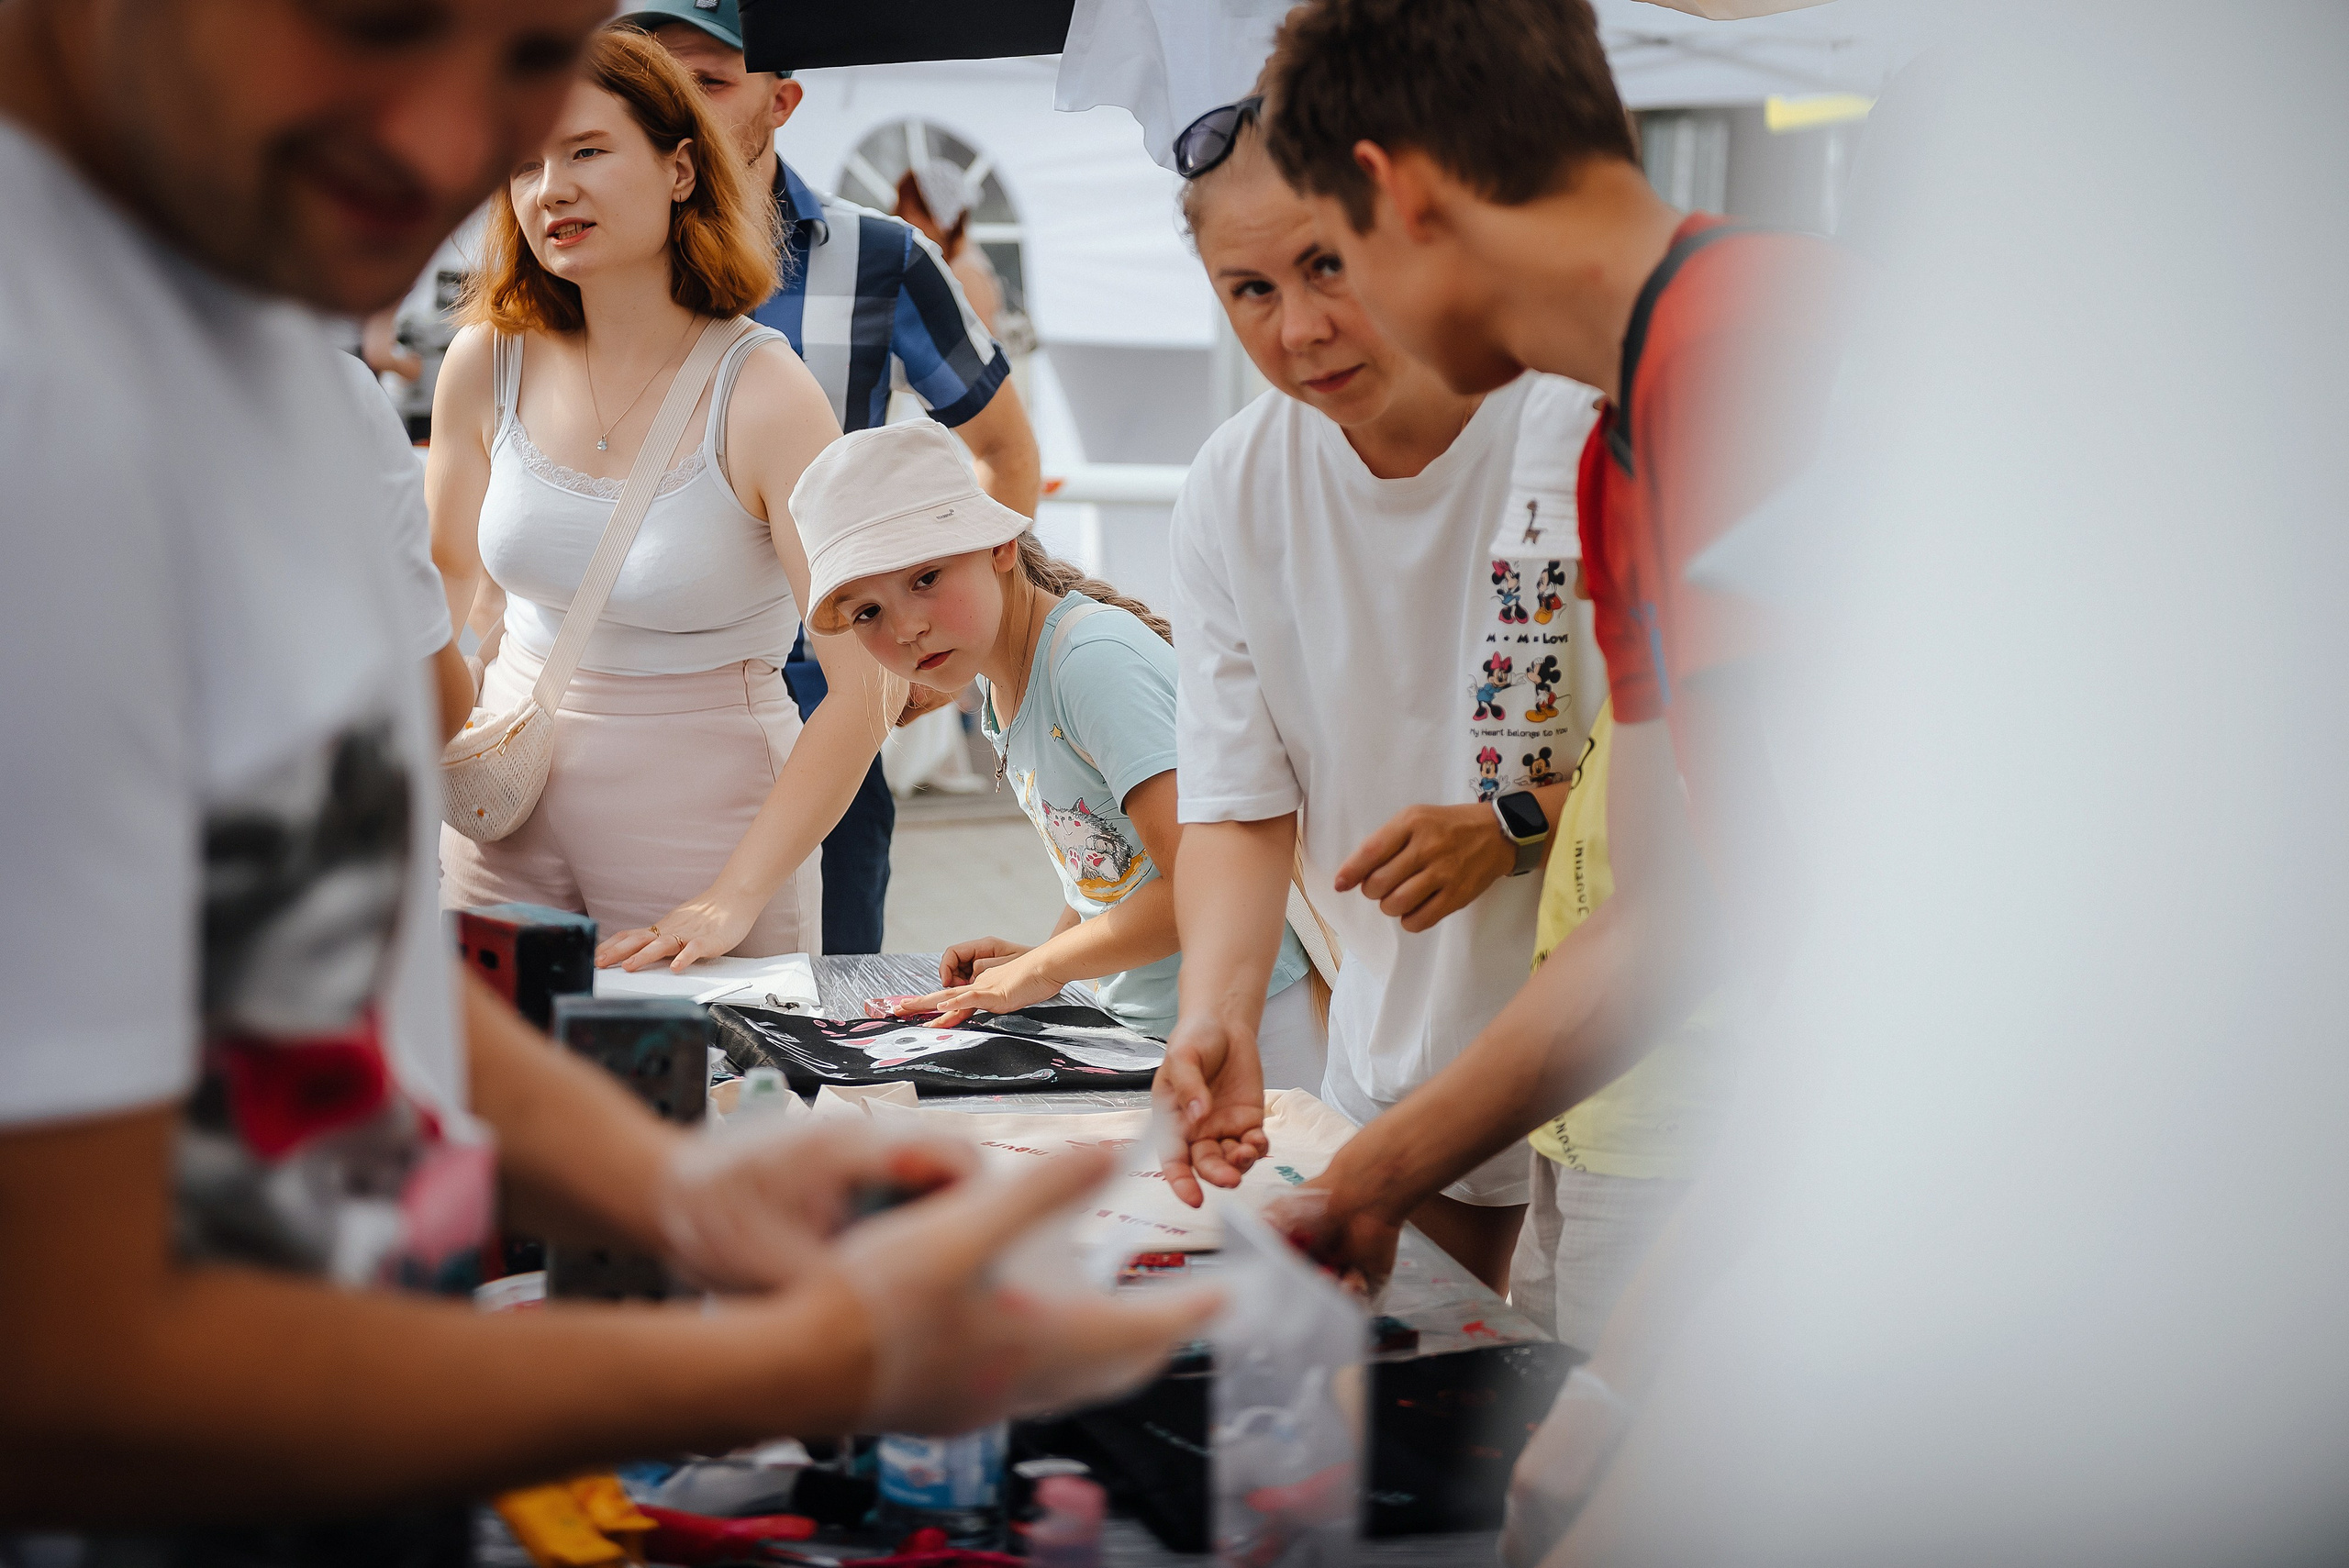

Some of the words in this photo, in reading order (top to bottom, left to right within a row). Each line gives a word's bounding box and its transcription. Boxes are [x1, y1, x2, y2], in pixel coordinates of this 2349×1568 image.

[1486, 633, 1496, 642] M
[1517, 633, 1529, 643] M
[1507, 728, 1540, 739] Belongs
[1542, 728, 1553, 737] to
